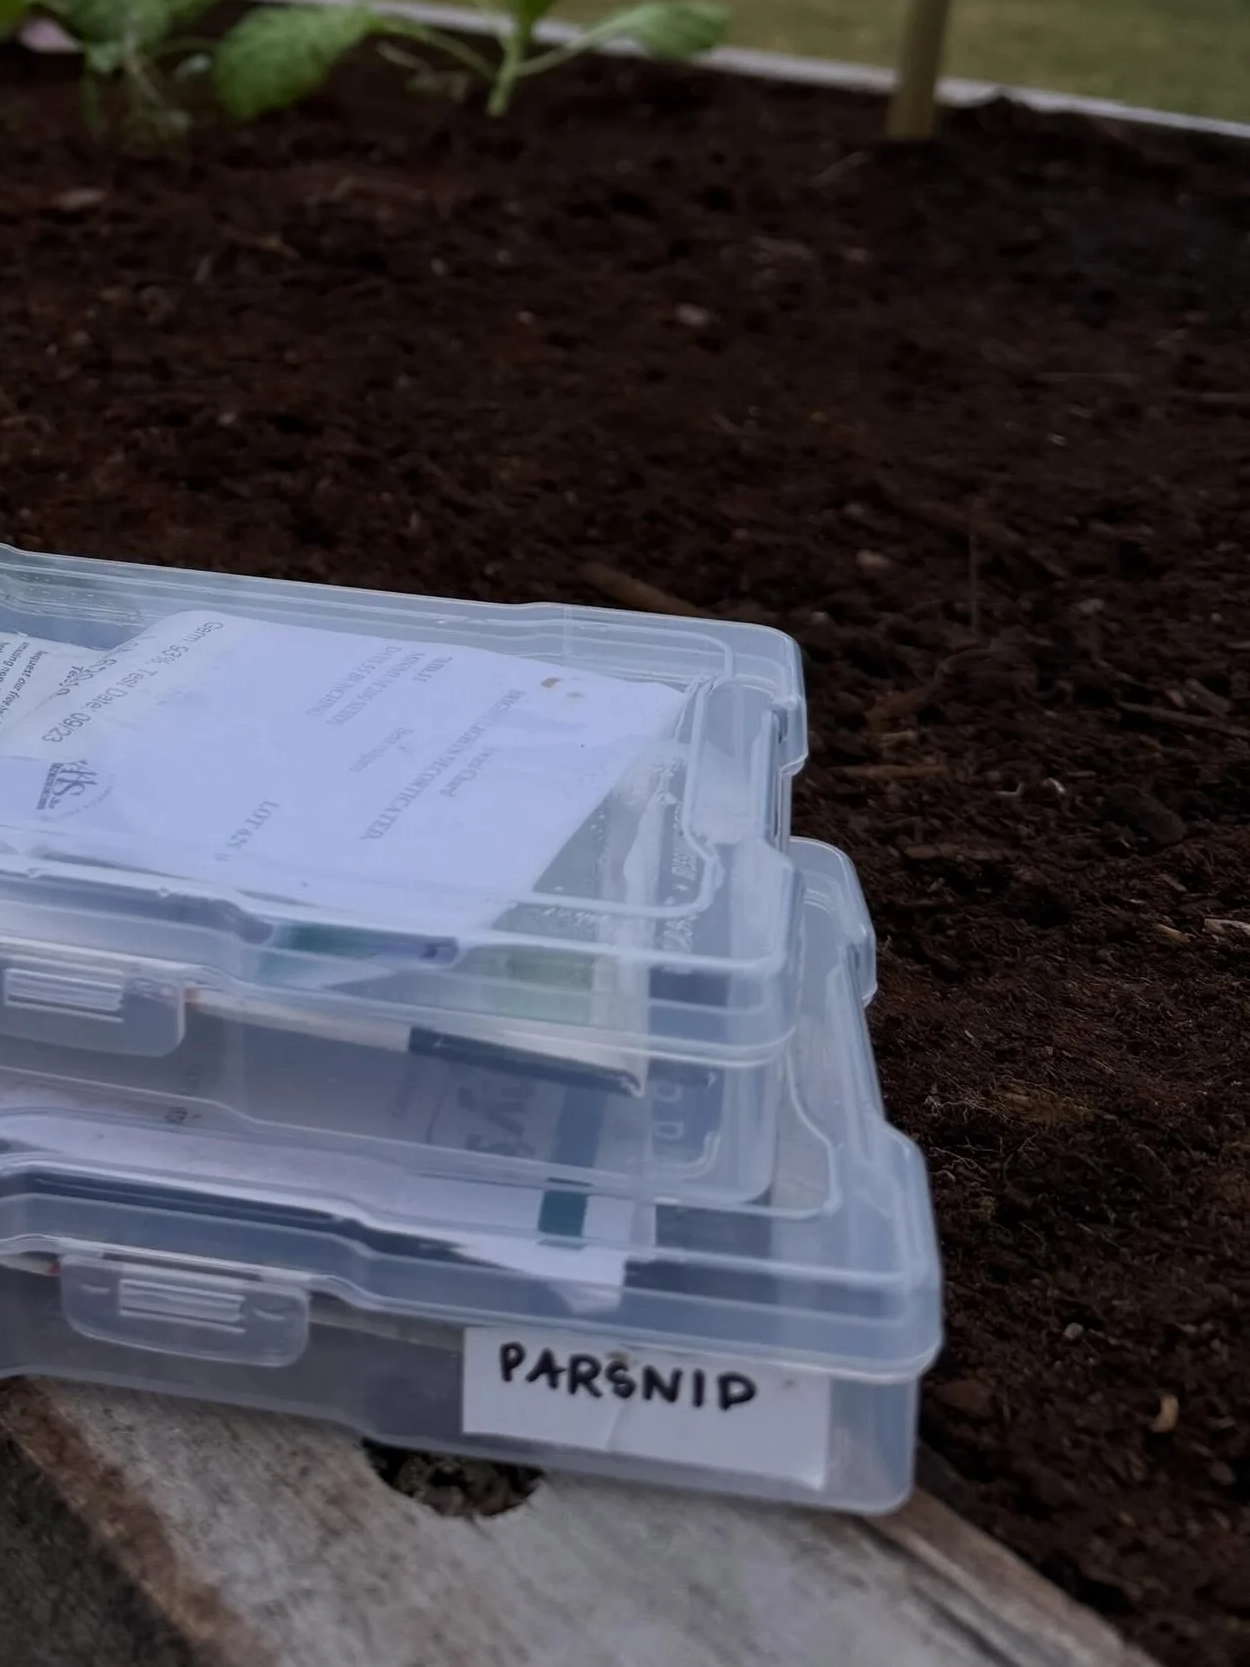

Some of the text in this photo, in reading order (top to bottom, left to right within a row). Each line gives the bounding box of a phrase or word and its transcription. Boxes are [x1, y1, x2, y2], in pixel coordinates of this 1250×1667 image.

[116, 668, 158, 688] Test
[41, 711, 91, 742] 09/23
[245, 800, 280, 829] LOT
[501, 1344, 755, 1409] PARSNIP
